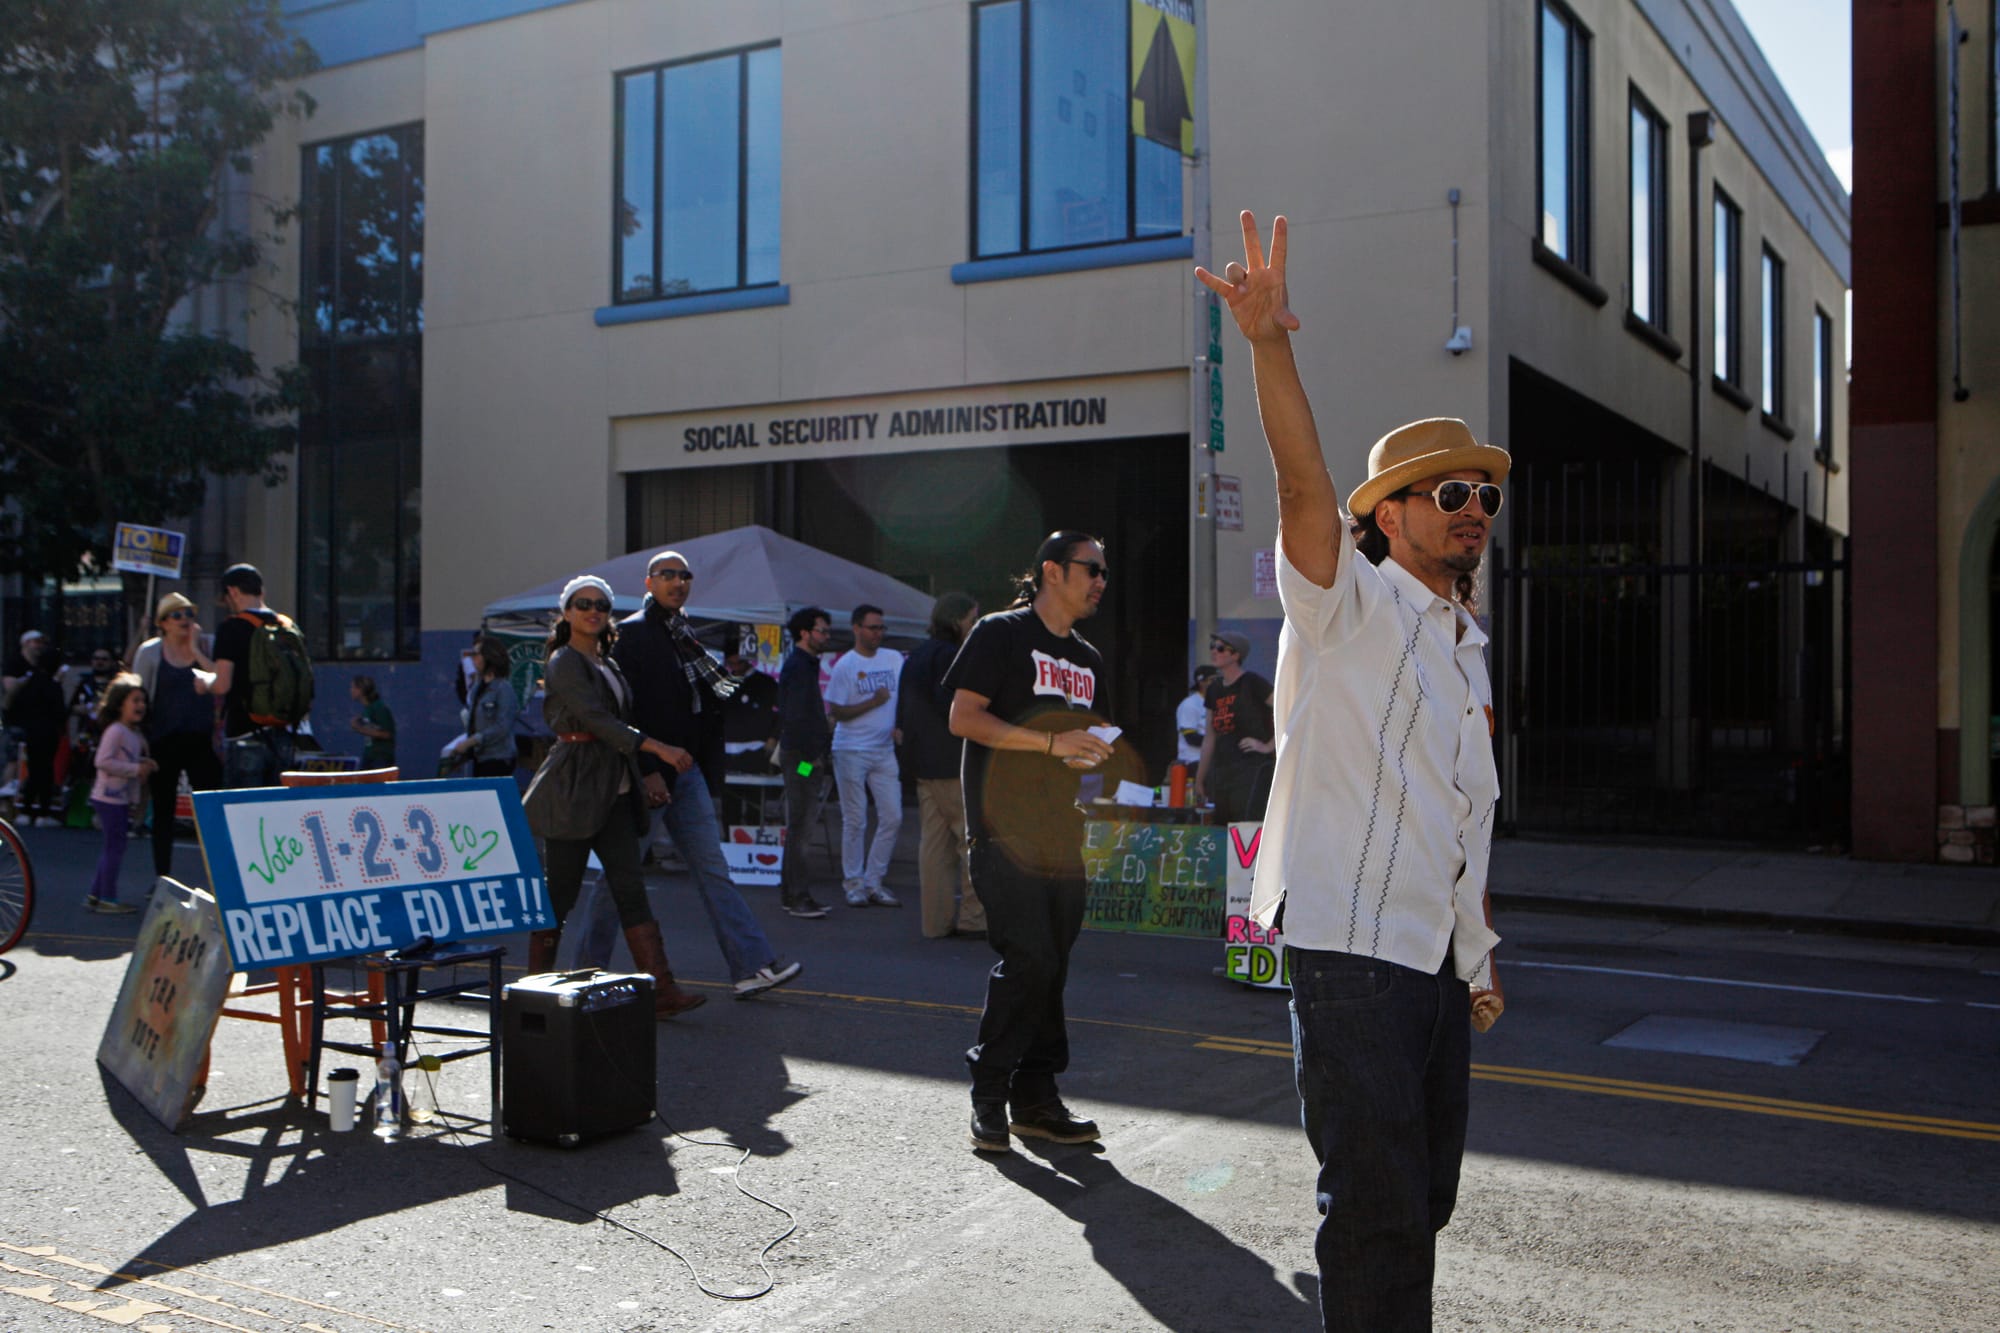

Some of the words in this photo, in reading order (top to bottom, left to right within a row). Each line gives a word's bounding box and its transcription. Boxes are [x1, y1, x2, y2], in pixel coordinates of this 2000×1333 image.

[683, 422, 760, 453] SOCIAL
[768, 413, 879, 446] SECURITY
[888, 397, 1107, 438] ADMINISTRATION
[121, 527, 169, 553] TOM
[1038, 659, 1093, 701] FRSCO
[248, 817, 304, 884] Vote
[448, 823, 477, 854] to
[1121, 854, 1146, 884] ED
[1159, 852, 1209, 887] LEE
[225, 894, 392, 965] REPLACE
[403, 888, 450, 941] ED
[1226, 946, 1277, 984] ED
